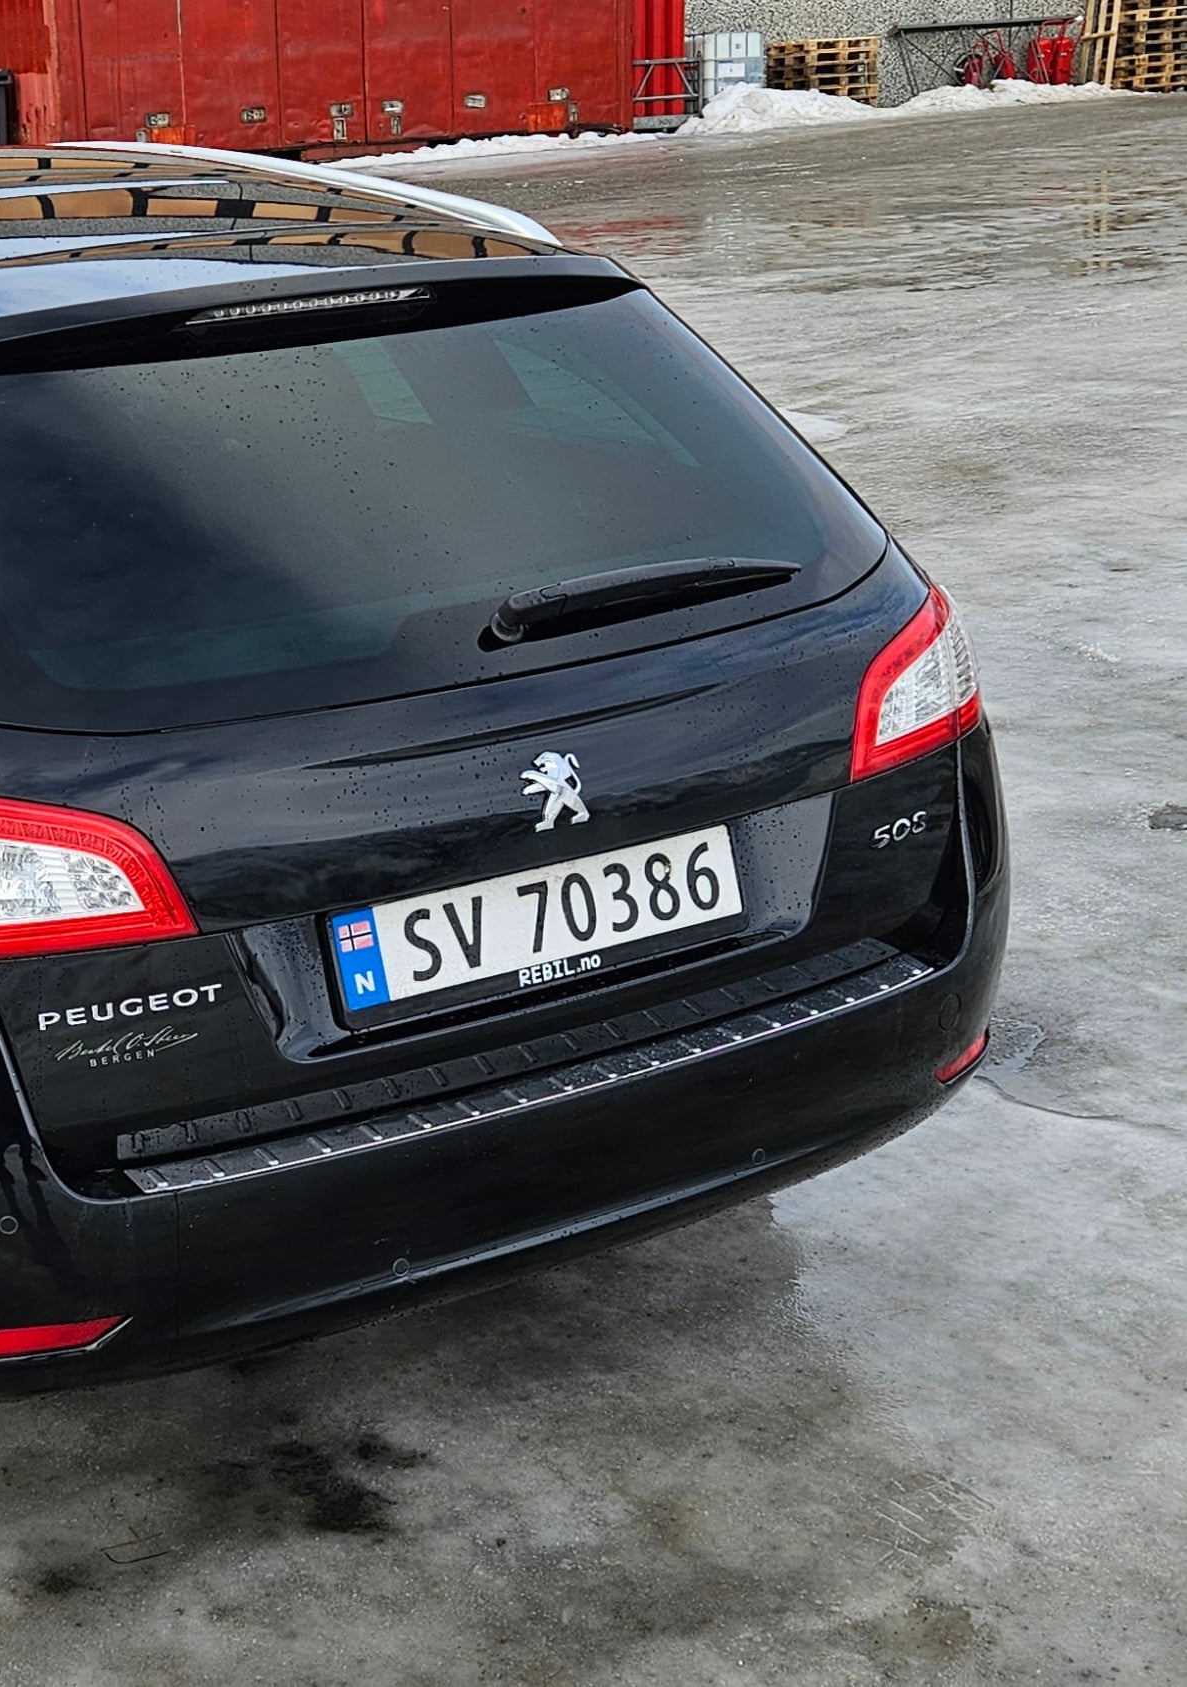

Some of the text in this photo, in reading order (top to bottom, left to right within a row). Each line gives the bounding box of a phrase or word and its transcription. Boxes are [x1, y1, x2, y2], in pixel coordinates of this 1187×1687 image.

[870, 810, 927, 849] 508
[403, 842, 720, 982] SV 70386
[354, 970, 376, 995] N
[518, 954, 601, 988] REBIL.no
[37, 983, 222, 1031] PEUGEOT
[89, 1049, 155, 1068] BERGEN
